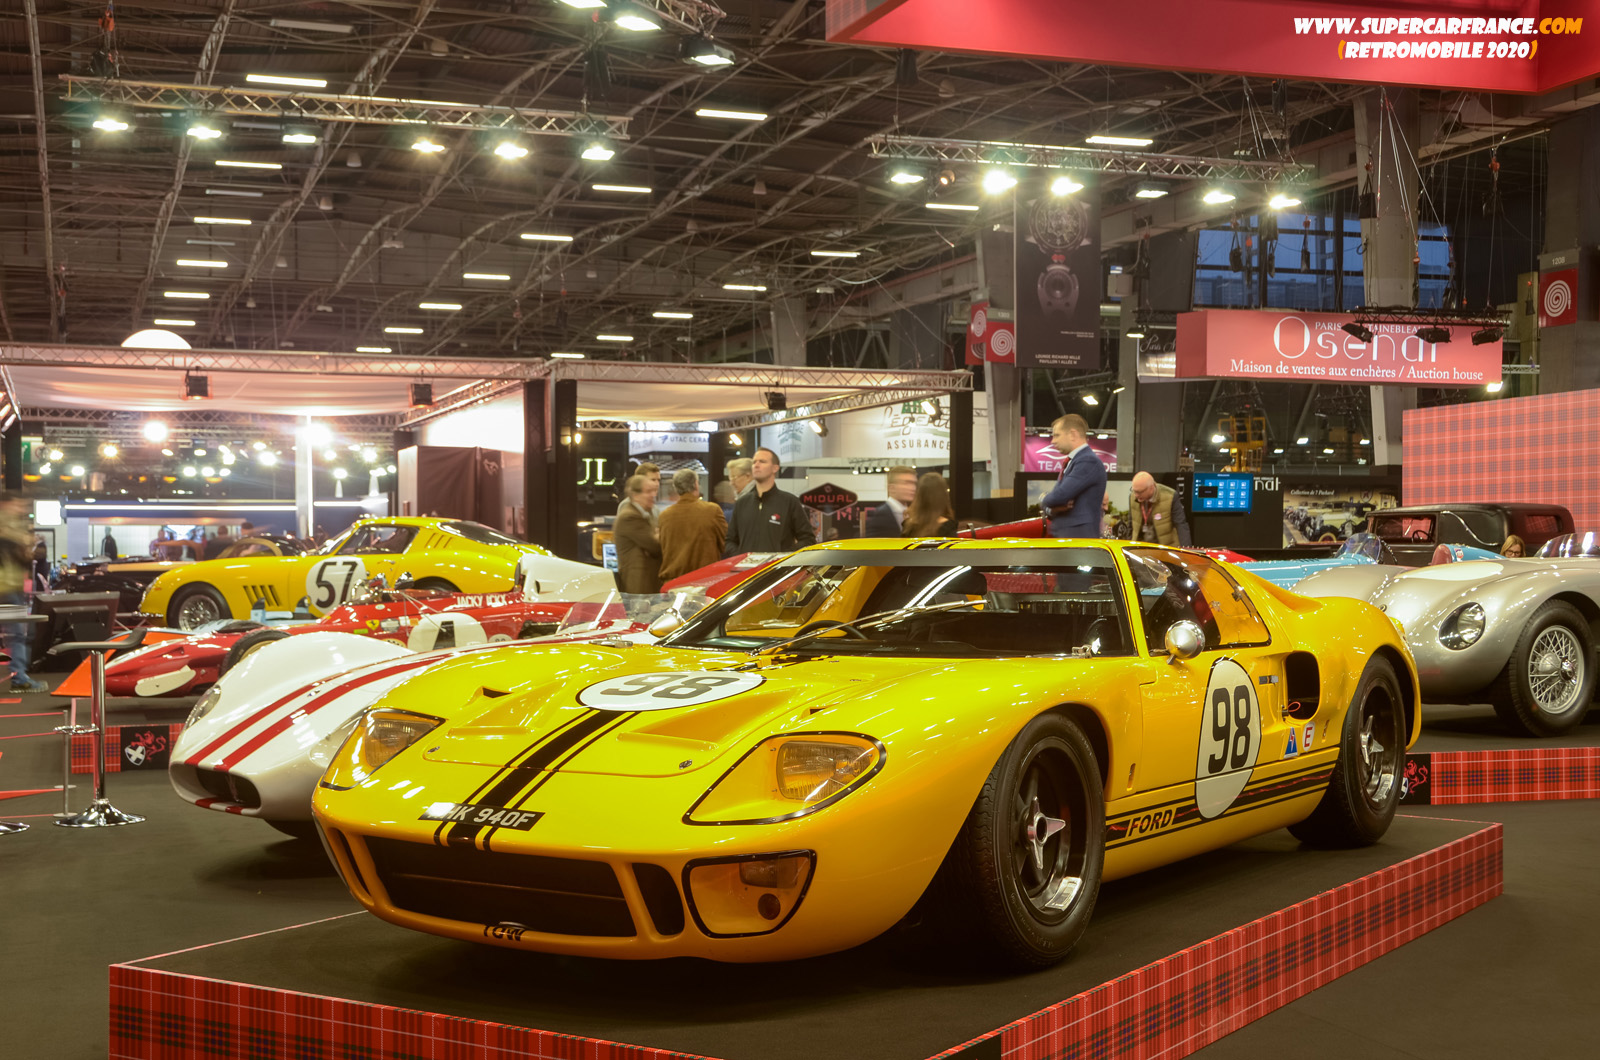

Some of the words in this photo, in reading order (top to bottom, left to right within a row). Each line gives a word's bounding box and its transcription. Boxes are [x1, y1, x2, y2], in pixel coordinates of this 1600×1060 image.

[1315, 321, 1342, 331] PARIS
[1364, 323, 1426, 334] TAINEBLEA
[1230, 359, 1272, 373] Maison
[1275, 361, 1289, 374] de
[1292, 363, 1326, 376] ventes
[1328, 366, 1348, 377] aux
[1350, 365, 1396, 378] enchères
[1406, 366, 1450, 379] Auction
[1452, 367, 1484, 380] house
[1038, 460, 1062, 471] TEA
[1254, 477, 1281, 491] nat
[803, 494, 853, 503] MIDUAL
[316, 561, 358, 608] 57
[600, 674, 740, 699] 98
[1208, 684, 1250, 774] 98
[1304, 727, 1313, 747] E
[473, 808, 536, 827] 940F
[1128, 809, 1174, 837] FORD
